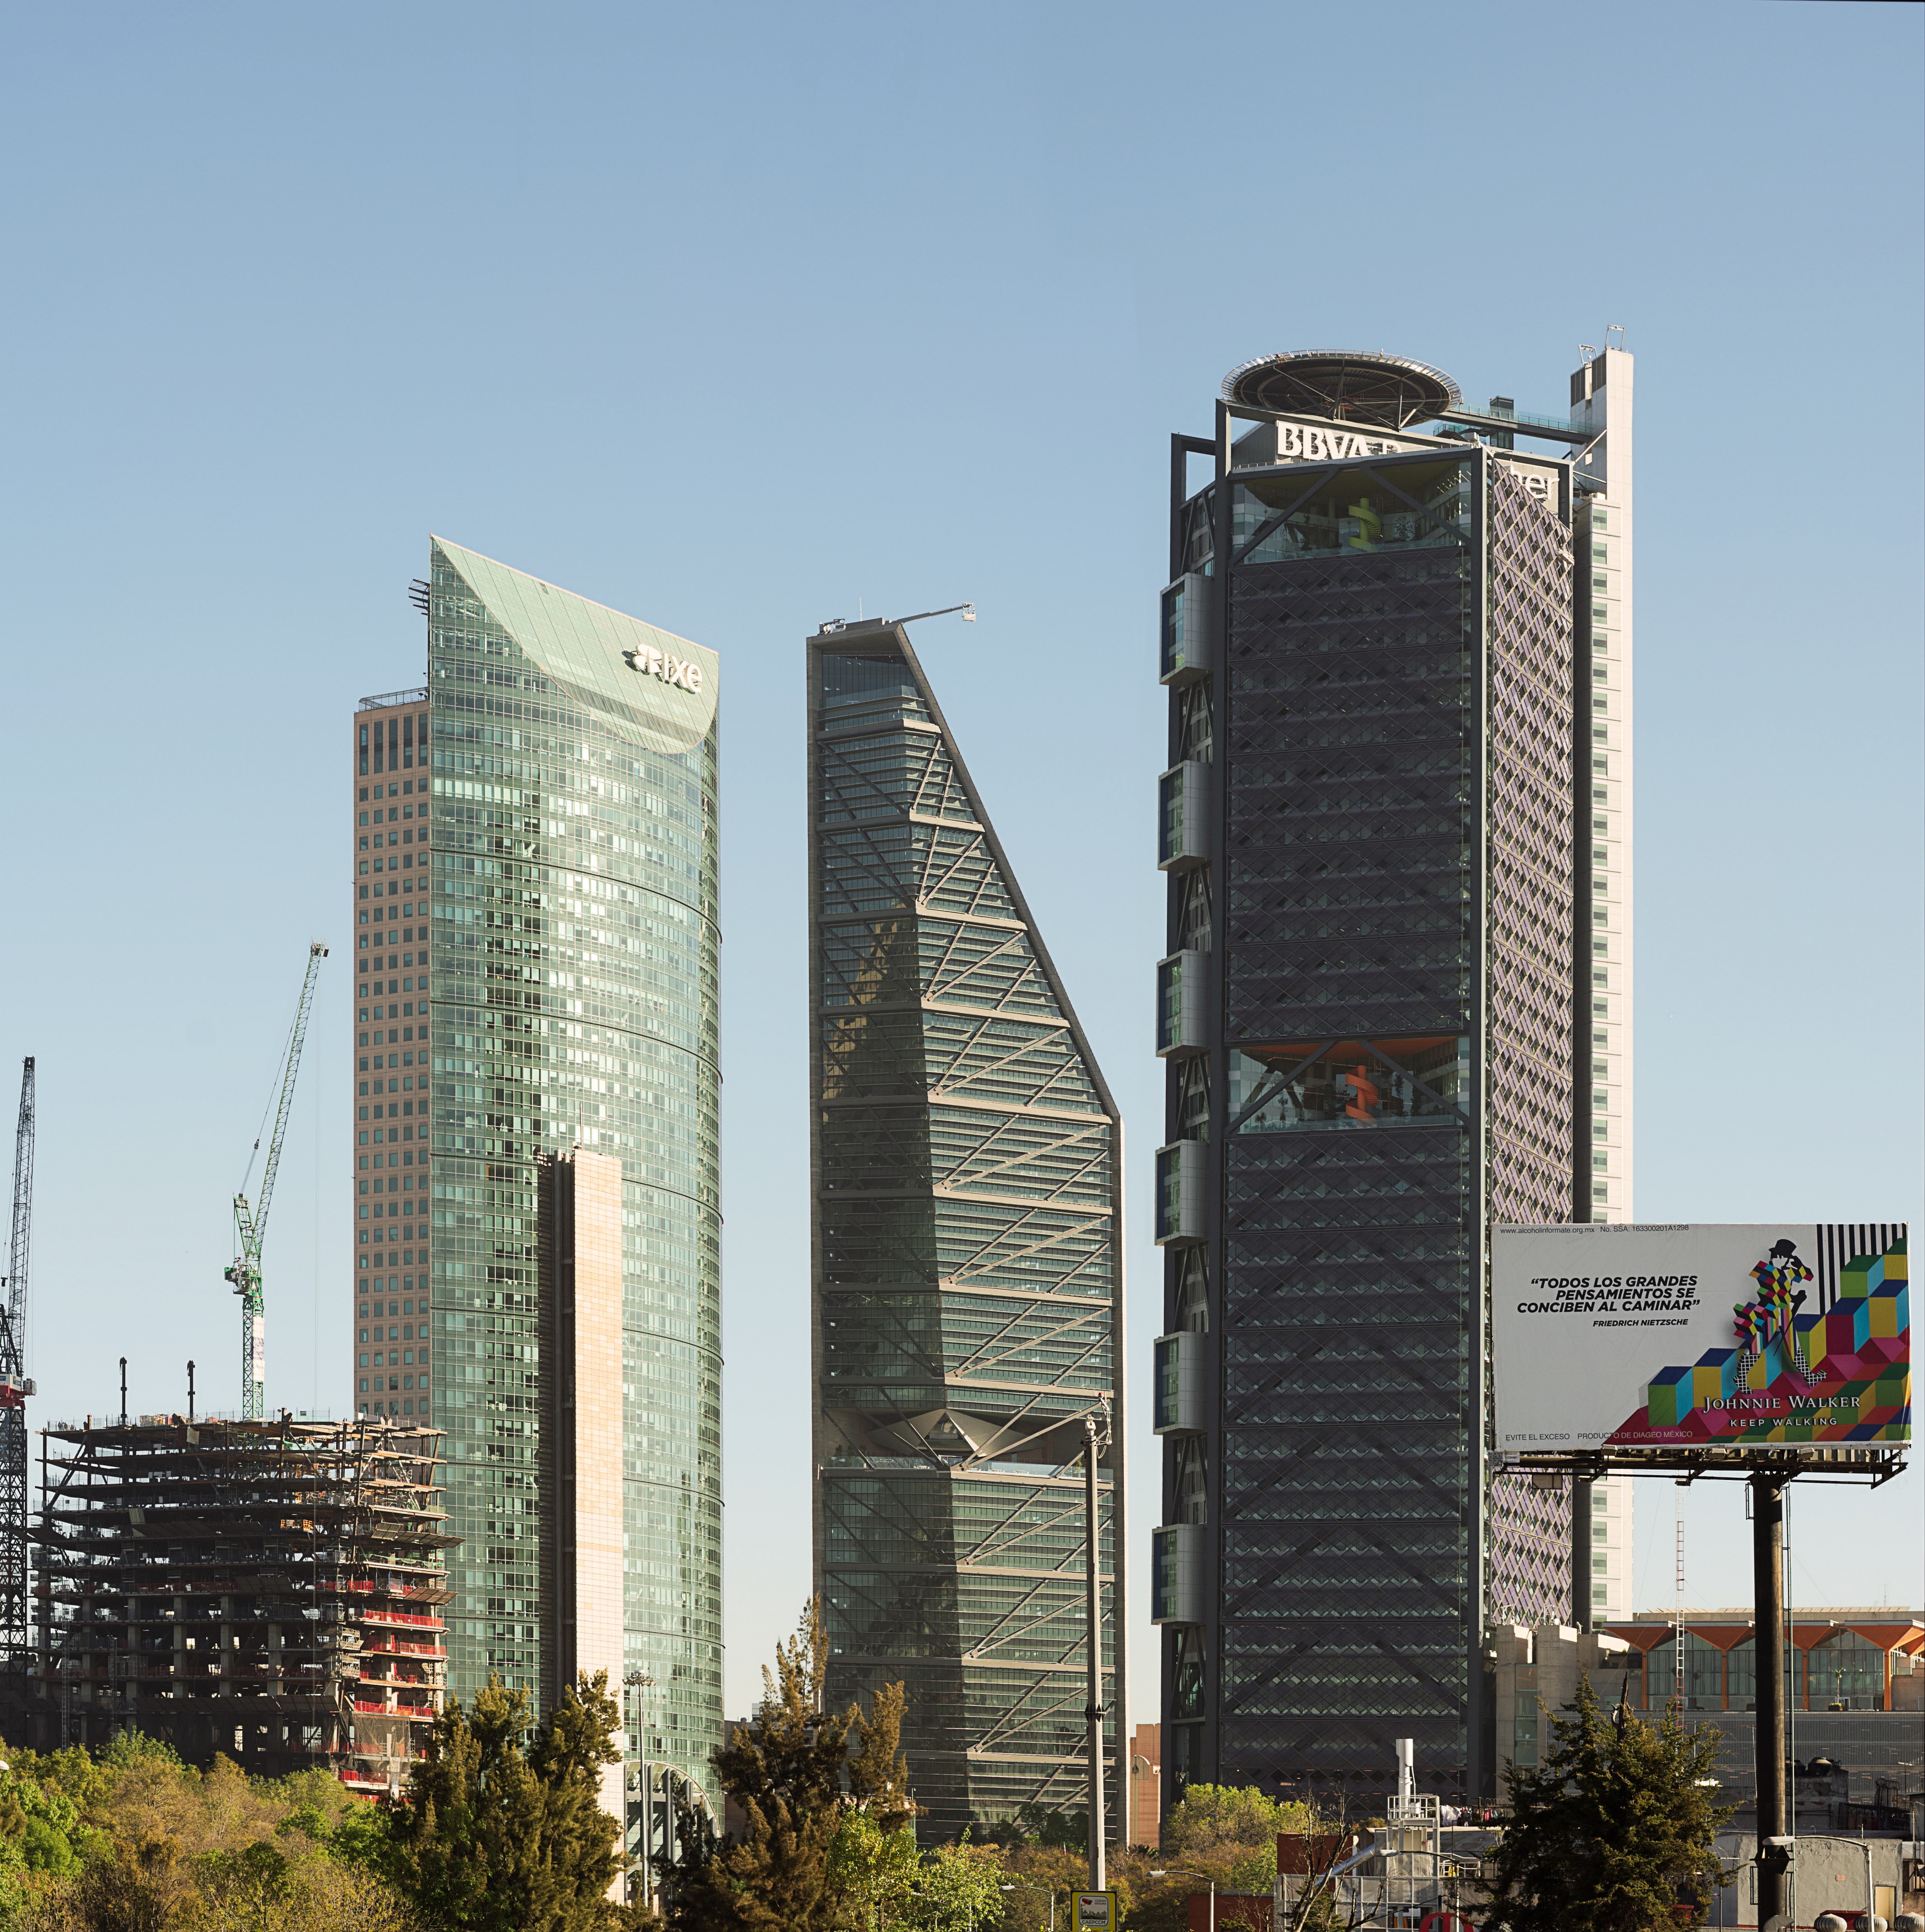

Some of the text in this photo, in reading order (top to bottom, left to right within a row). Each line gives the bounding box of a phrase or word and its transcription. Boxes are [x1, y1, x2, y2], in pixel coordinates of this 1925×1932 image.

[1277, 421, 1371, 460] BBVA
[1593, 1277, 1622, 1288] LOS
[1626, 1275, 1698, 1287] GRANDES
[1556, 1287, 1696, 1300] PENSAMIENTOS SE
[1517, 1302, 1595, 1313] CONCIBEN
[1597, 1301, 1617, 1312] AL
[1703, 1395, 1860, 1413] JOHNNIE WALKER
[1773, 1418, 1837, 1426] WALKING
[1663, 1430, 1693, 1438] MÉXICO
